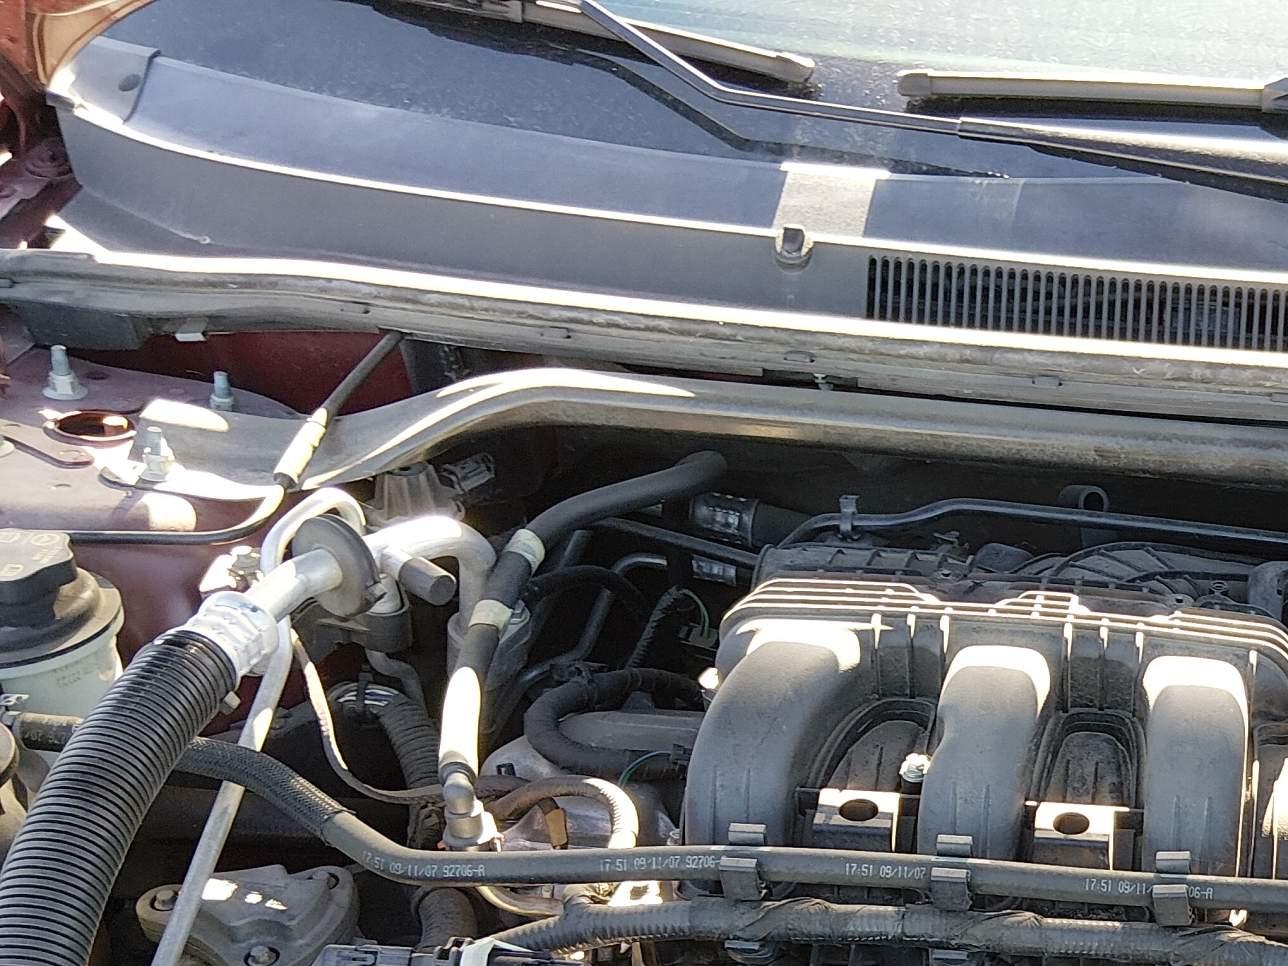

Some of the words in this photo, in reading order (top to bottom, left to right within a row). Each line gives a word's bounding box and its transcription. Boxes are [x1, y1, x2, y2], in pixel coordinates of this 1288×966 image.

[685, 855, 722, 869] 92706-
[845, 863, 873, 877] 17:51
[879, 865, 926, 880] 09/11/07
[1085, 878, 1112, 893] 17:51
[1118, 880, 1153, 895] 09/11/
[1188, 886, 1213, 900] 06-A
